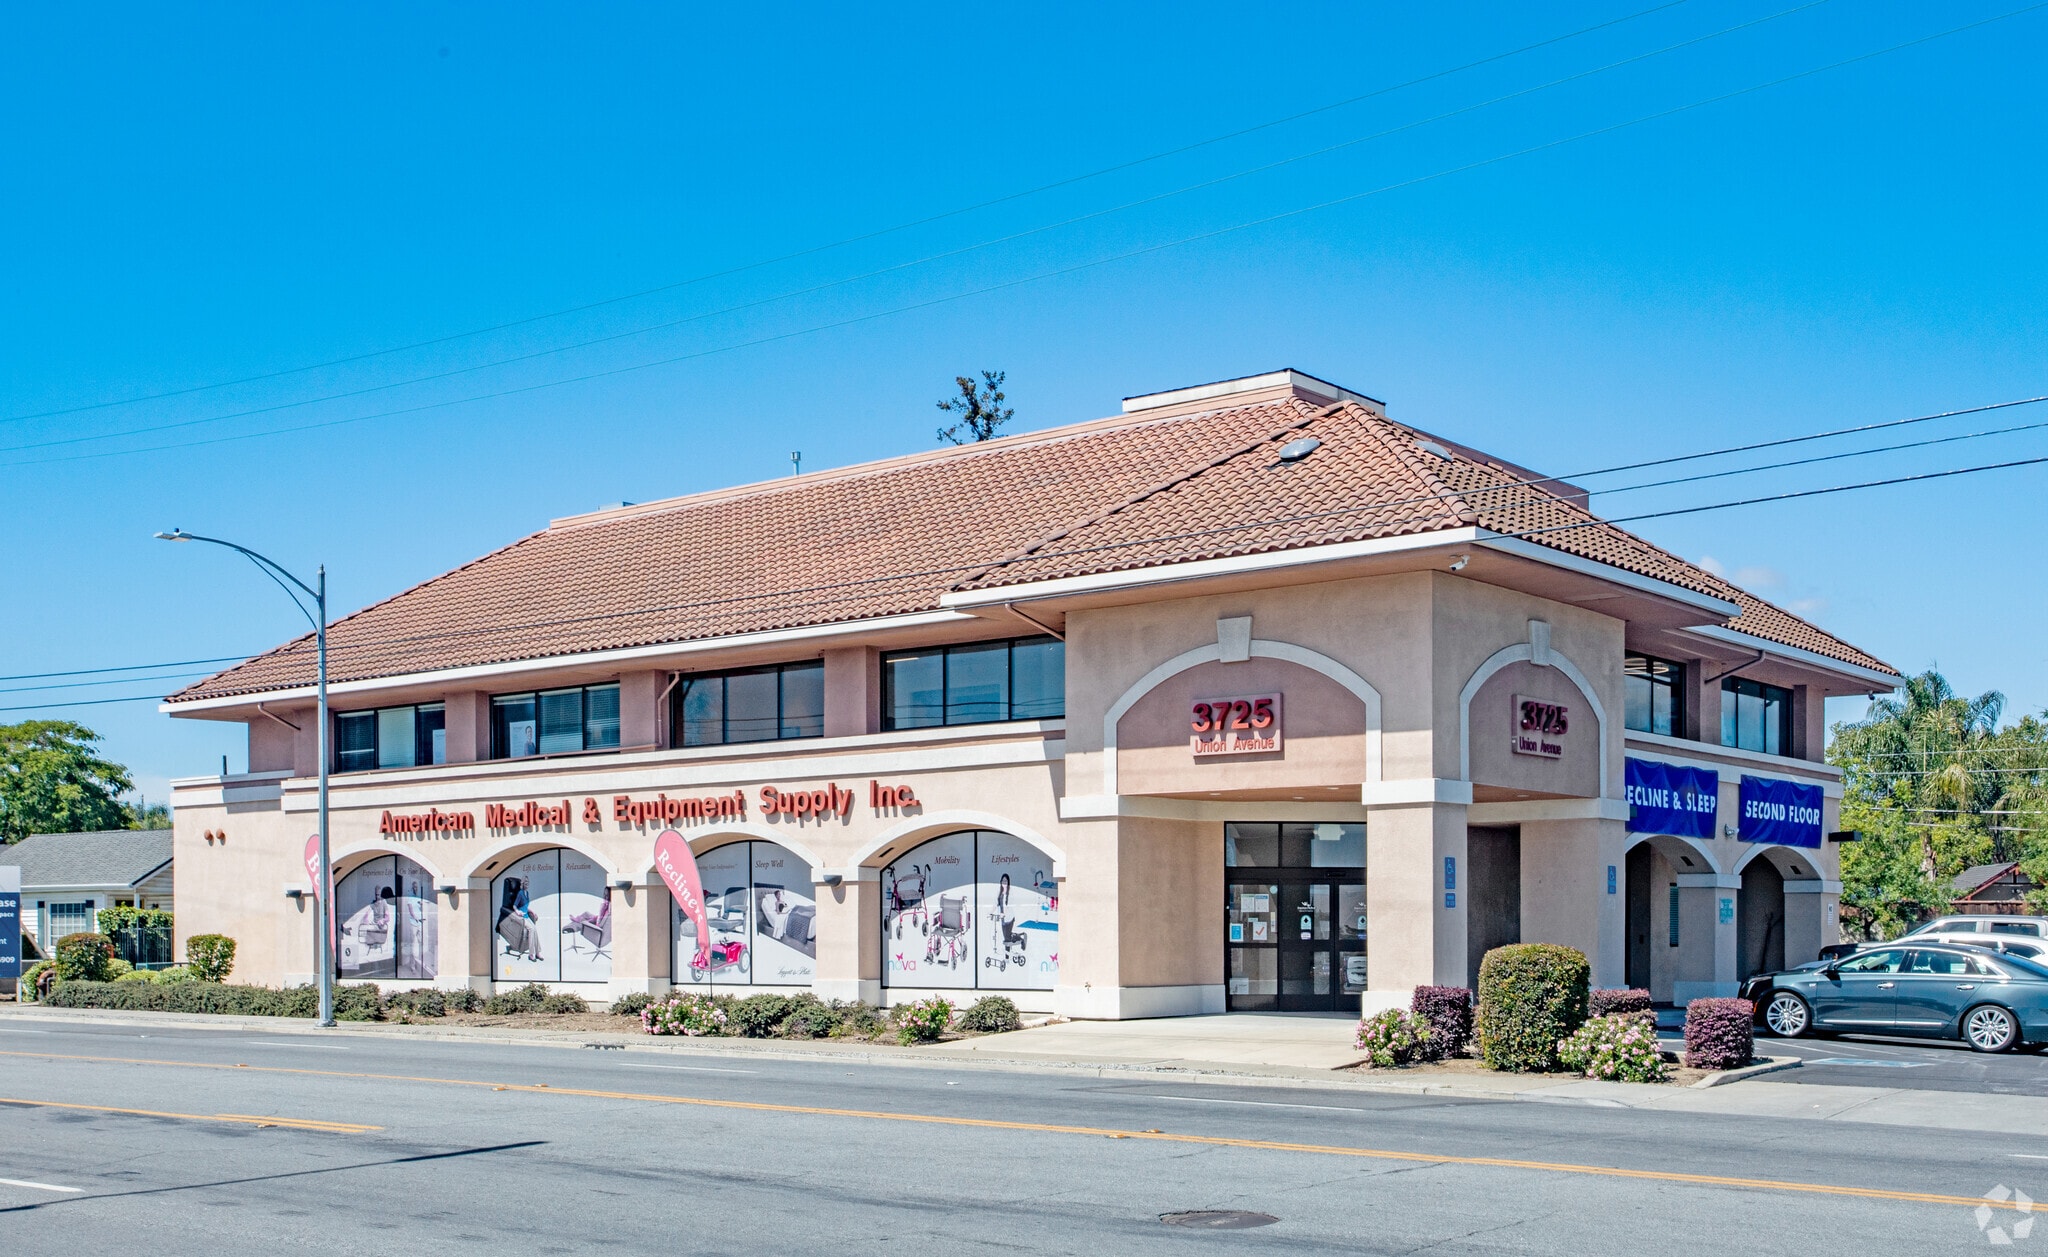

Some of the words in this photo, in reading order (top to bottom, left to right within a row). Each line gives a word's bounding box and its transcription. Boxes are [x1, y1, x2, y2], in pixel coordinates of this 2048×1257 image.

[1191, 698, 1274, 732] 3725
[1521, 701, 1568, 735] 3725
[1195, 737, 1226, 753] Union
[1233, 736, 1274, 751] Avenue
[1519, 735, 1537, 751] Union
[1540, 739, 1562, 755] Avenue
[378, 807, 475, 834] American
[485, 799, 570, 829] Medical
[582, 797, 600, 824] &
[613, 789, 747, 827] Equipment
[759, 782, 853, 818] Supply
[869, 779, 921, 808] Inc.
[1673, 791, 1682, 810] &
[1686, 792, 1716, 814] SLEEP
[1745, 800, 1785, 821] SECOND
[1789, 805, 1820, 826] FLOOR
[566, 863, 591, 871] Relaxation
[755, 860, 769, 871] Sleep
[771, 859, 784, 868] Well
[934, 855, 961, 866] Mobility
[991, 854, 1020, 866] Lifestyles
[658, 848, 704, 924] Recliners
[0, 899, 17, 908] ase
[888, 959, 916, 972] nova
